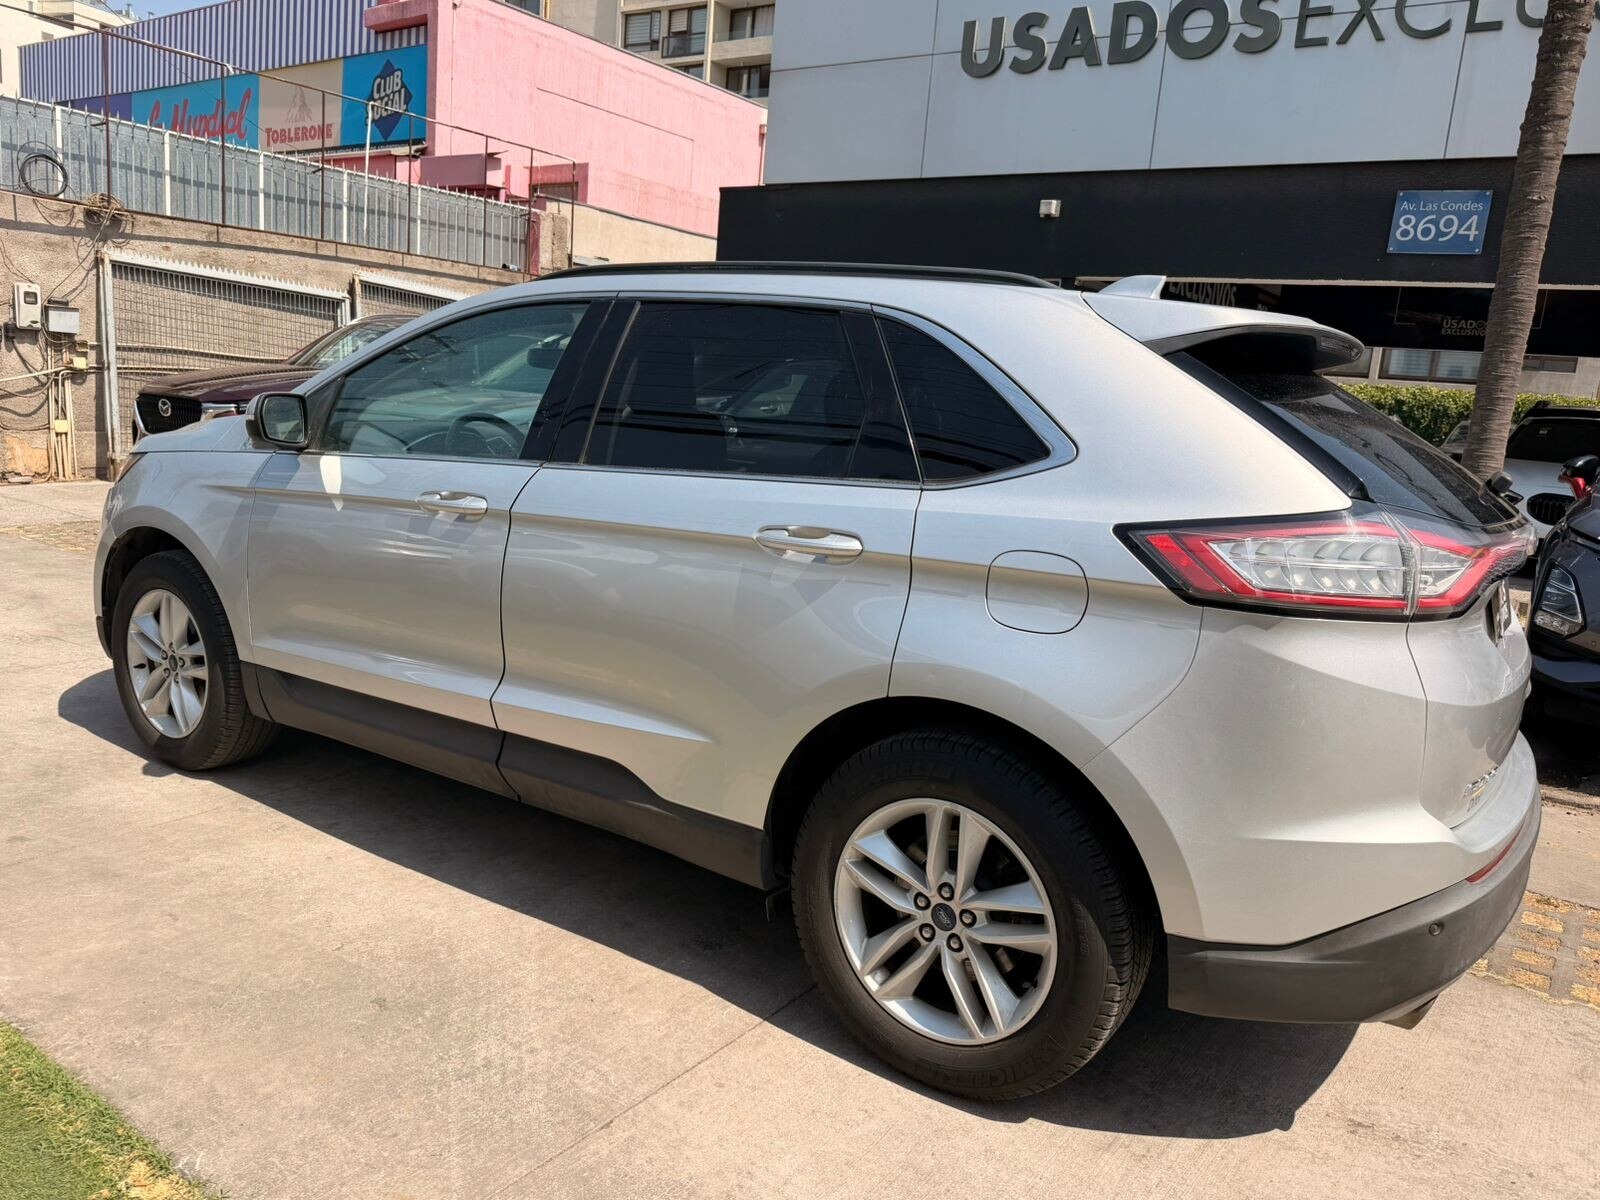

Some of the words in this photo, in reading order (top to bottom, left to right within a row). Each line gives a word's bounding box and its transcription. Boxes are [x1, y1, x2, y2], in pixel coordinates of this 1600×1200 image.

[961, 0, 1282, 78] USADOS
[373, 70, 402, 99] CLUB
[265, 123, 333, 147] TOBLERONE
[1400, 200, 1417, 211] Av.
[1420, 200, 1438, 211] Las
[1440, 200, 1484, 211] Condes
[1395, 214, 1479, 242] 8694
